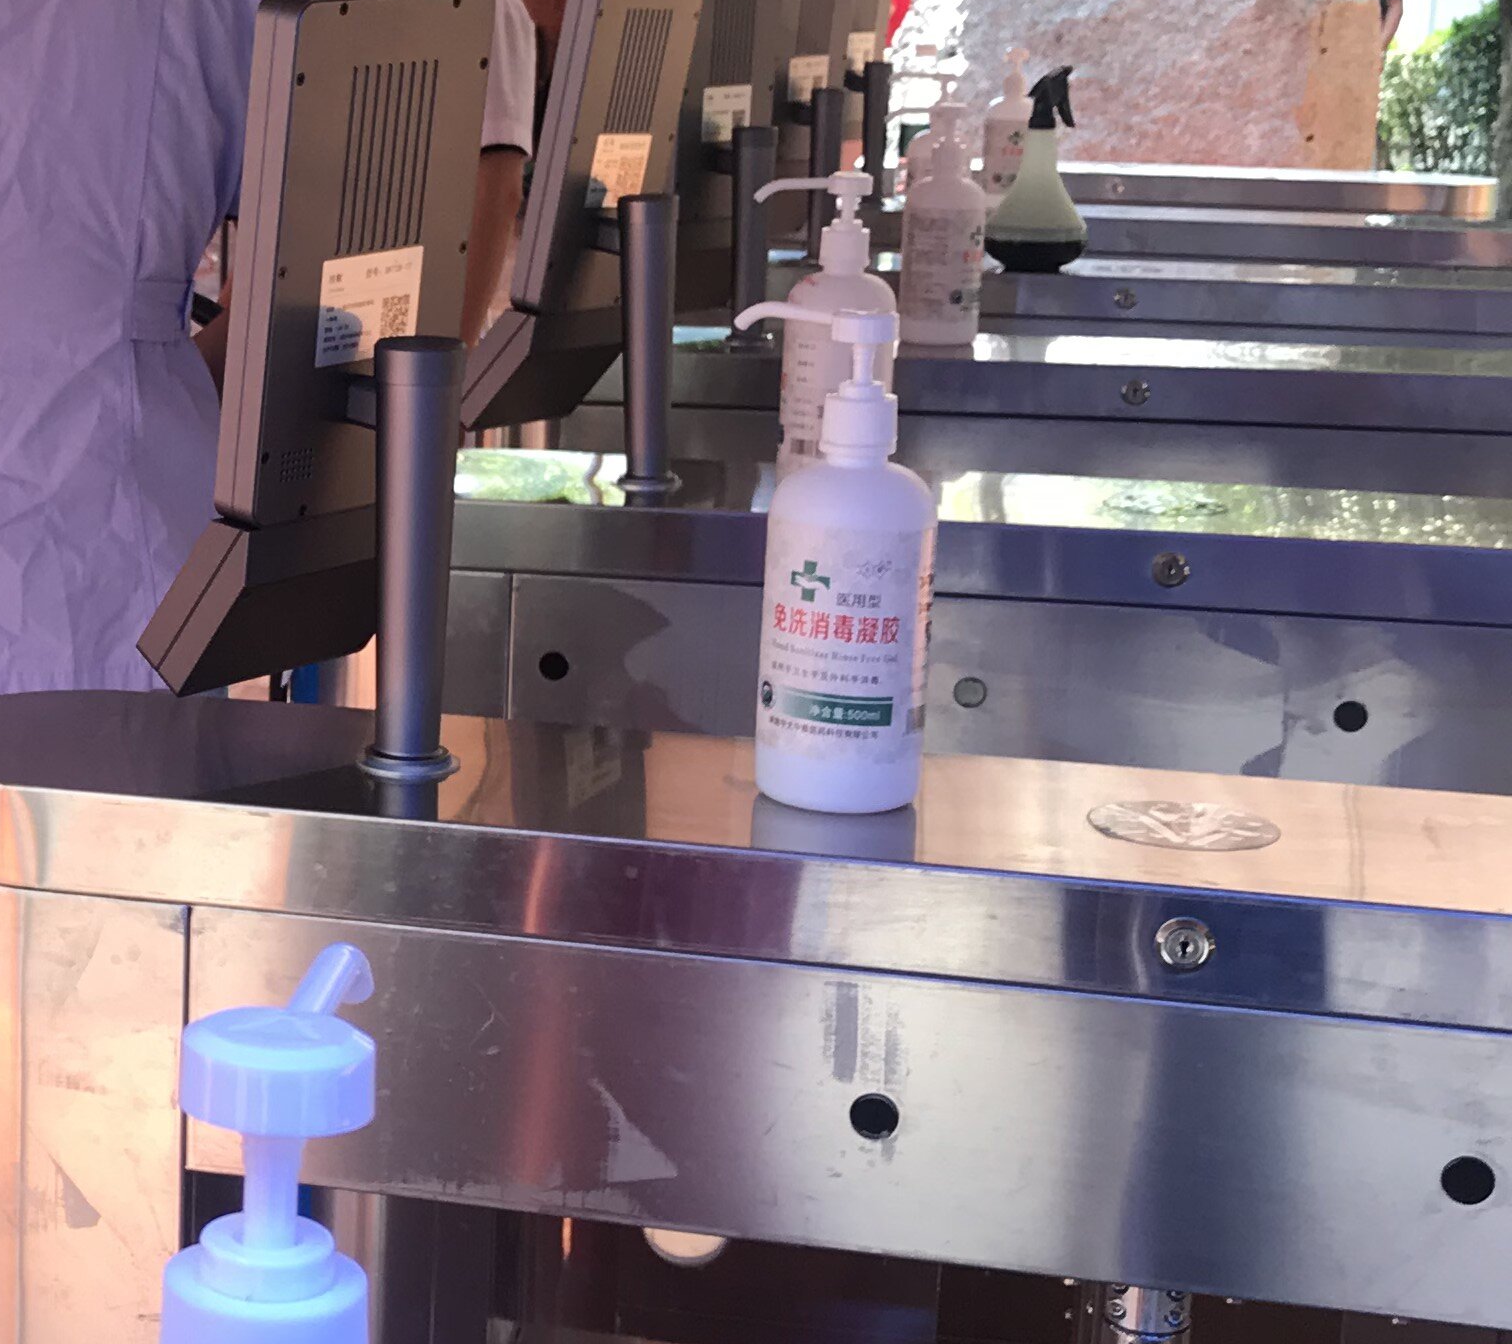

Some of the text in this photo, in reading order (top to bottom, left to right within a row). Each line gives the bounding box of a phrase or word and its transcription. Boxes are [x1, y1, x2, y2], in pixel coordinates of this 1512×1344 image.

[835, 592, 882, 609] 医用型
[773, 602, 900, 644] 免洗消毒凝胶
